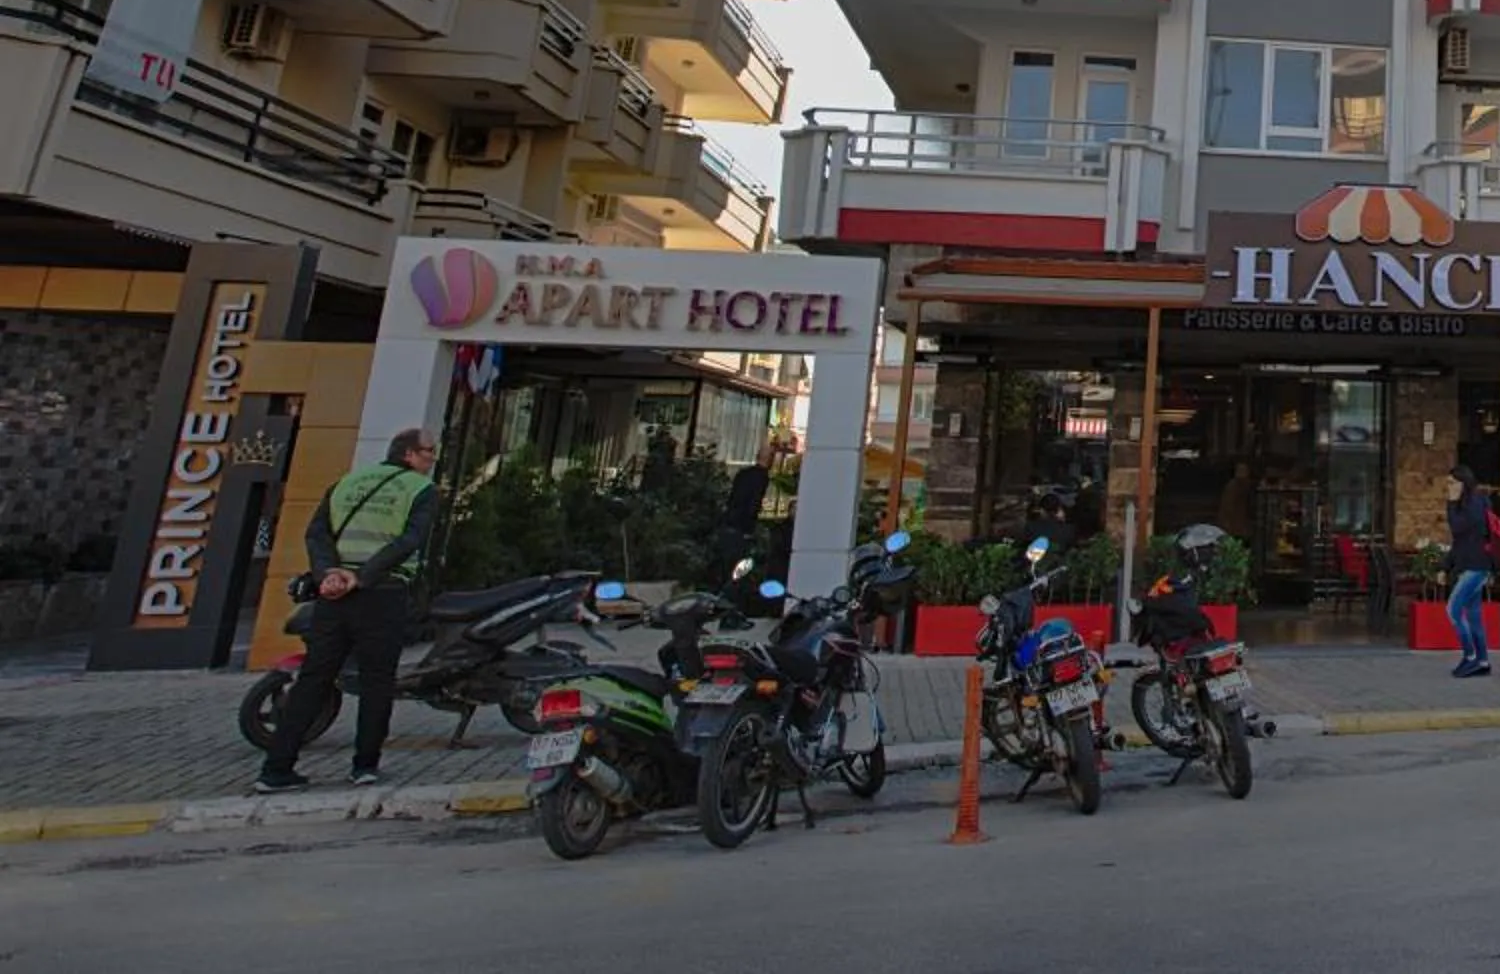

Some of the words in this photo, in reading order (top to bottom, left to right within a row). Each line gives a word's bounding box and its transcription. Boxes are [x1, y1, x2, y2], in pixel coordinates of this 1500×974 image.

[495, 281, 677, 330] APART
[686, 289, 847, 336] HOTEL
[138, 411, 232, 616] PRINCE
[202, 292, 253, 402] HOTEL
